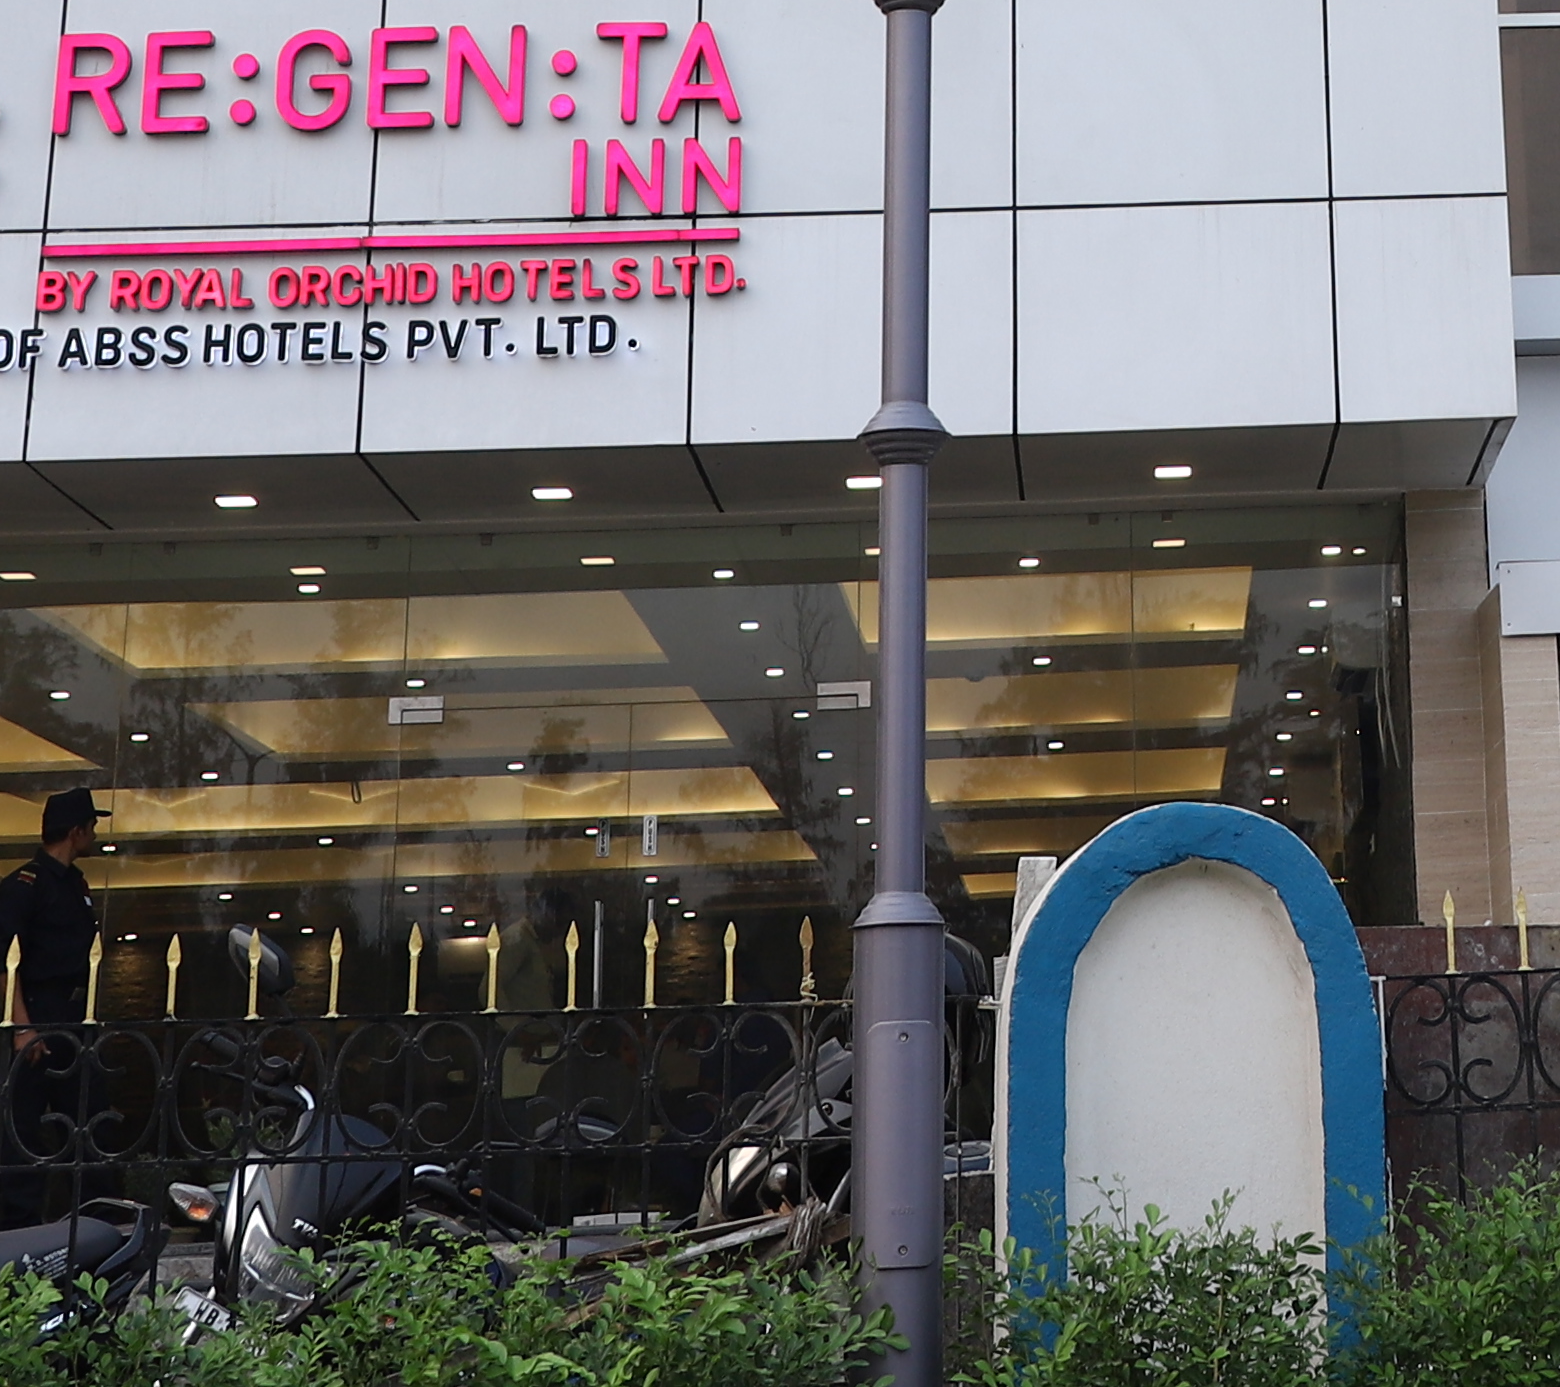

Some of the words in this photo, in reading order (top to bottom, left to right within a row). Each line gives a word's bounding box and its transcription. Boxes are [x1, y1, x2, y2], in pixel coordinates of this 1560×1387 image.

[51, 21, 742, 136] RE:GEN:TA
[570, 136, 743, 216] INN
[35, 269, 98, 314] BY
[110, 267, 253, 312] ROYAL
[268, 262, 440, 309] ORCHID
[452, 257, 642, 304] HOTELS
[651, 251, 748, 298] LTD.
[58, 323, 190, 369] ABSS
[203, 319, 388, 365] HOTELS
[406, 316, 517, 361] PVT.
[536, 312, 642, 357] LTD.
